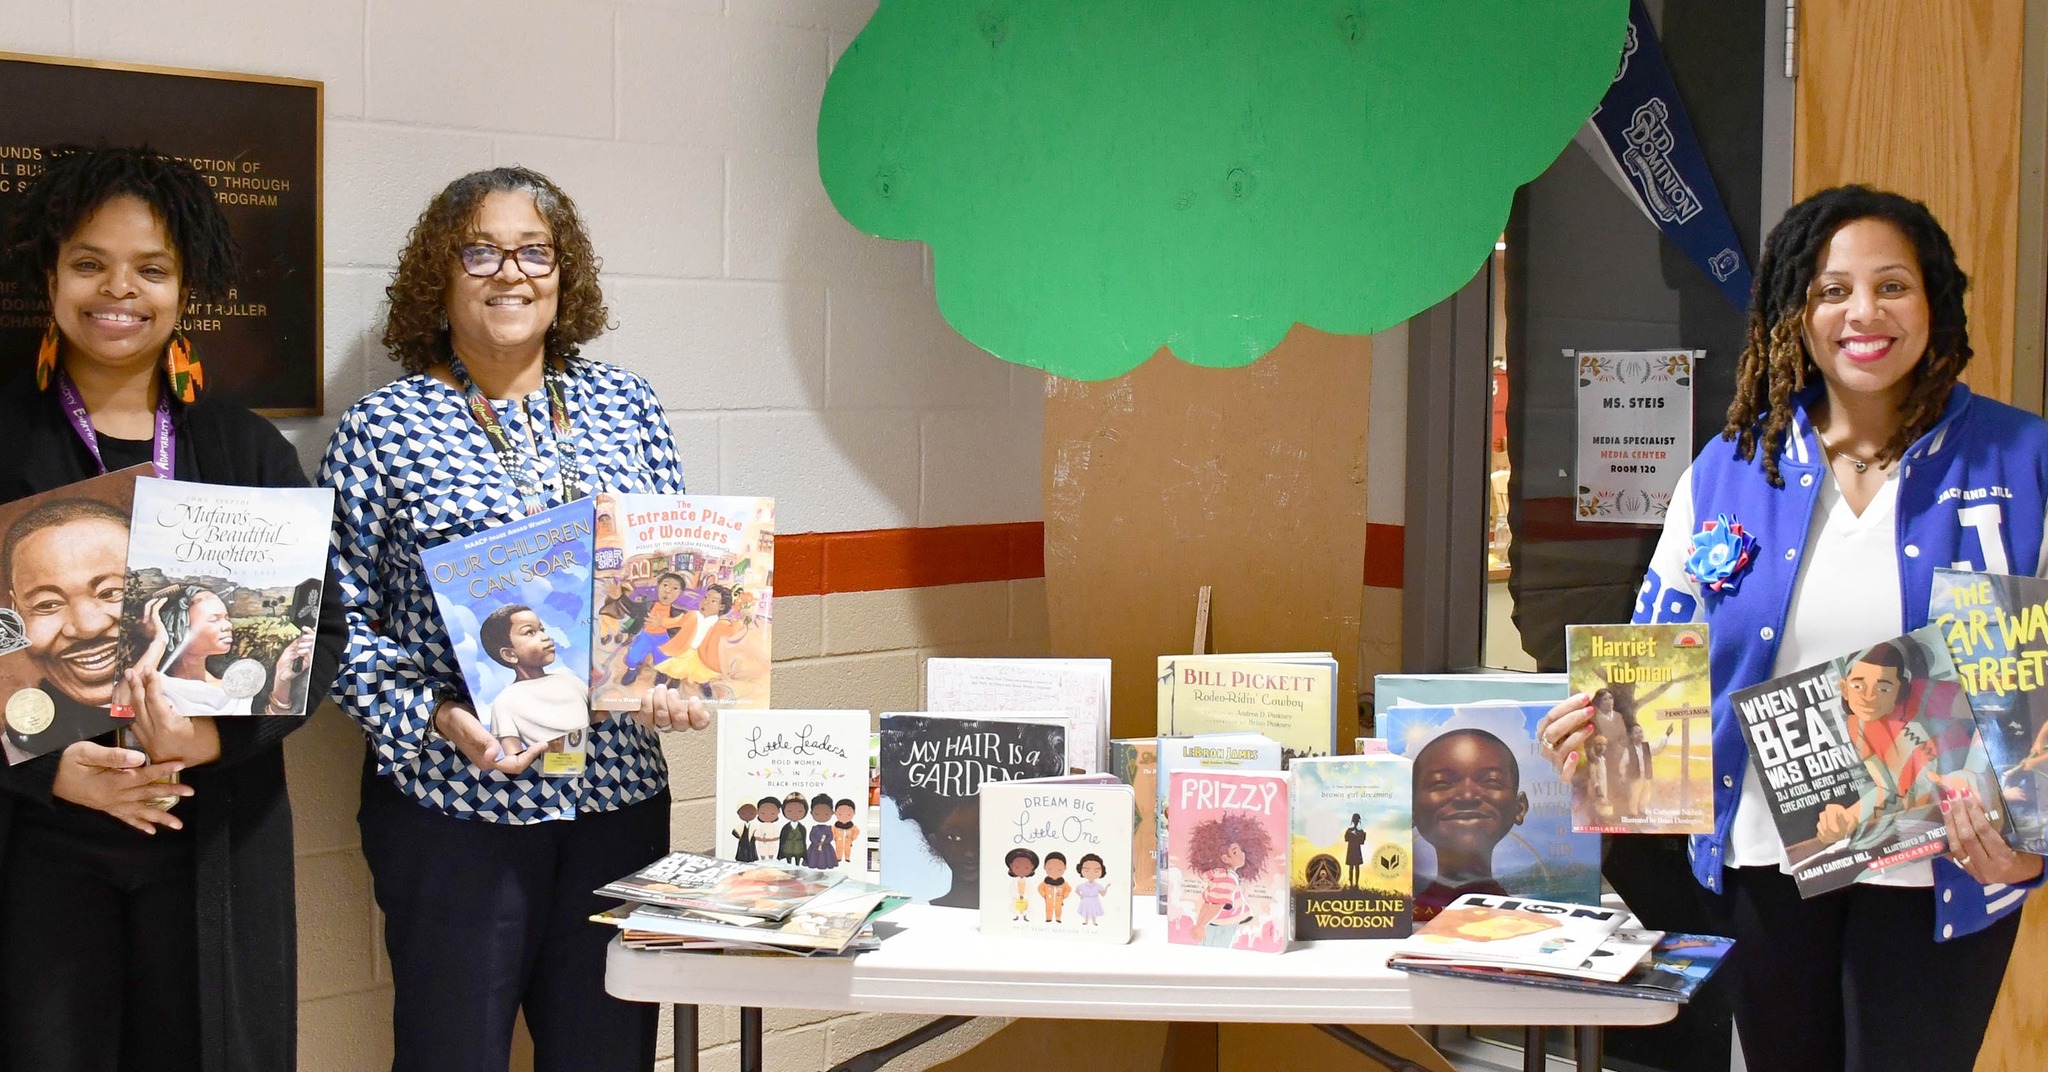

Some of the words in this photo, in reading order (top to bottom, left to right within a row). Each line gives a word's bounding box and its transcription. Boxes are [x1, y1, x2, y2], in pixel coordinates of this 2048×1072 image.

[1635, 110, 1670, 151] OLD
[242, 162, 261, 173] OF
[1630, 117, 1696, 217] DOMINION
[223, 177, 290, 191] THROUGH
[1603, 398, 1625, 409] MS.
[1629, 397, 1665, 409] STEIS
[156, 417, 169, 471] ADAPTABILITY
[1593, 437, 1620, 445] MEDIA
[1623, 436, 1675, 445] SPECIALIST
[1601, 450, 1628, 459] MEDIA
[1631, 451, 1666, 459] CENTER
[1611, 465, 1637, 473] ROOM
[1640, 465, 1656, 473] 120
[1963, 487, 1987, 500] AND
[1989, 486, 2013, 498] JILL
[677, 500, 691, 509] The
[627, 509, 696, 527] Entrance
[701, 509, 743, 531] Place
[183, 521, 298, 547] Beautiful
[464, 538, 487, 549] NAACP
[639, 526, 655, 542] of
[660, 525, 728, 544] Wonders
[175, 540, 274, 574] Daughters
[433, 554, 485, 583] OUR
[488, 517, 591, 565] CHILDREN
[469, 570, 517, 598] CAN
[519, 550, 579, 582] SOAR
[597, 559, 619, 569] SHOP
[1951, 581, 1992, 610] THE
[1592, 636, 1657, 658] Harriet
[1184, 668, 1226, 687] BILL
[1232, 671, 1315, 692] PICKETT
[1600, 662, 1673, 684] Tubman
[1262, 694, 1304, 711] Cowboy
[1740, 686, 1798, 724] WHEN
[1798, 671, 1842, 705] THE
[745, 726, 792, 759] Little
[793, 724, 848, 758] Leaders
[1749, 697, 1851, 769] BEAT
[899, 740, 941, 765] MY
[945, 732, 1003, 763] HAIR
[1226, 747, 1258, 760] JAMES
[1765, 760, 1804, 790] WAS
[1804, 742, 1860, 777] BORN
[1181, 778, 1278, 816] FRIZZY
[1347, 791, 1358, 800] girl
[1360, 791, 1393, 800] dreaming
[1775, 789, 1790, 802] DJ
[1790, 782, 1812, 797] KOOL
[1811, 775, 1835, 790] HERC
[1836, 770, 1850, 781] AND
[1024, 796, 1068, 808] DREAM
[1073, 798, 1096, 816] BIG,
[1780, 793, 1820, 814] CREATION
[1821, 788, 1832, 801] OF
[1833, 785, 1847, 797] HIP
[1012, 811, 1059, 844] Little
[1062, 816, 1100, 844] One
[1879, 842, 1940, 867] SCHOLASTIC
[1883, 838, 1919, 854] ILLUSTRATED
[1799, 865, 1823, 881] LABAN
[1823, 857, 1854, 873] CARRICK
[1854, 851, 1872, 865] HILL
[1305, 899, 1405, 914] JACQUELINE
[1315, 914, 1395, 928] WOODSON
